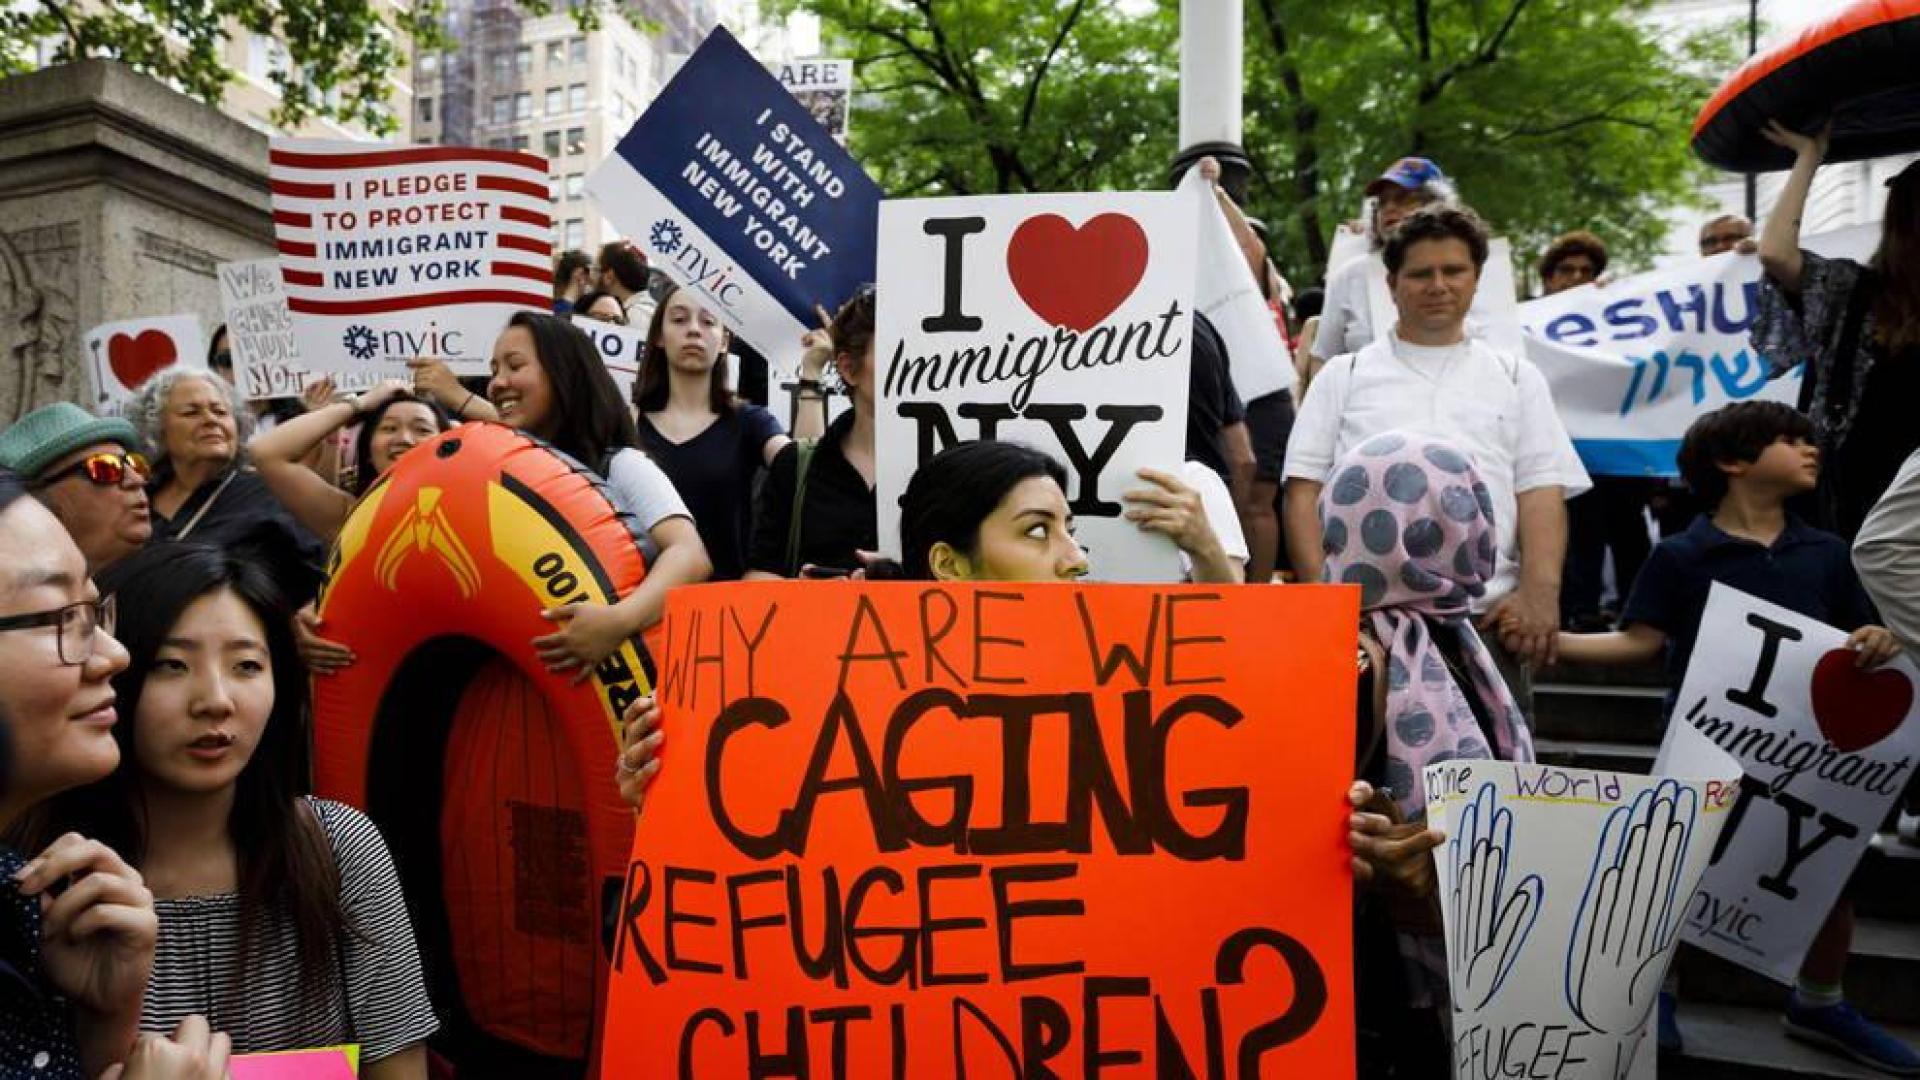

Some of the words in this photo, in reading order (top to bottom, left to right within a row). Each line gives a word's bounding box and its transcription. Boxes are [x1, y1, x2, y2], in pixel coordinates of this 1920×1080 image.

[779, 63, 839, 86] ARE
[345, 181, 352, 200] I
[364, 173, 468, 198] PLEDGE
[695, 131, 832, 261] IMMIGRANT
[751, 142, 817, 209] WITH
[755, 107, 773, 125] I
[769, 122, 846, 198] STAND
[322, 211, 358, 231] TO
[368, 202, 490, 229] PROTECT
[325, 230, 489, 261] IMMIGRANT
[681, 160, 744, 219] NEW
[742, 214, 808, 281] YORK
[333, 267, 398, 289] NEW
[408, 259, 482, 283] YORK
[676, 242, 745, 307] nyic
[922, 216, 986, 334] I
[383, 320, 465, 357] nyic
[883, 299, 1184, 411] Immigrant
[664, 601, 779, 718] WHY
[837, 588, 1026, 691] ARE
[1075, 590, 1227, 687] WE
[1725, 611, 1803, 719] I
[704, 687, 1251, 863] CAGING
[1514, 765, 1621, 801] World
[1684, 695, 1912, 797] Immigrant
[613, 859, 1086, 991] REFUGEE
